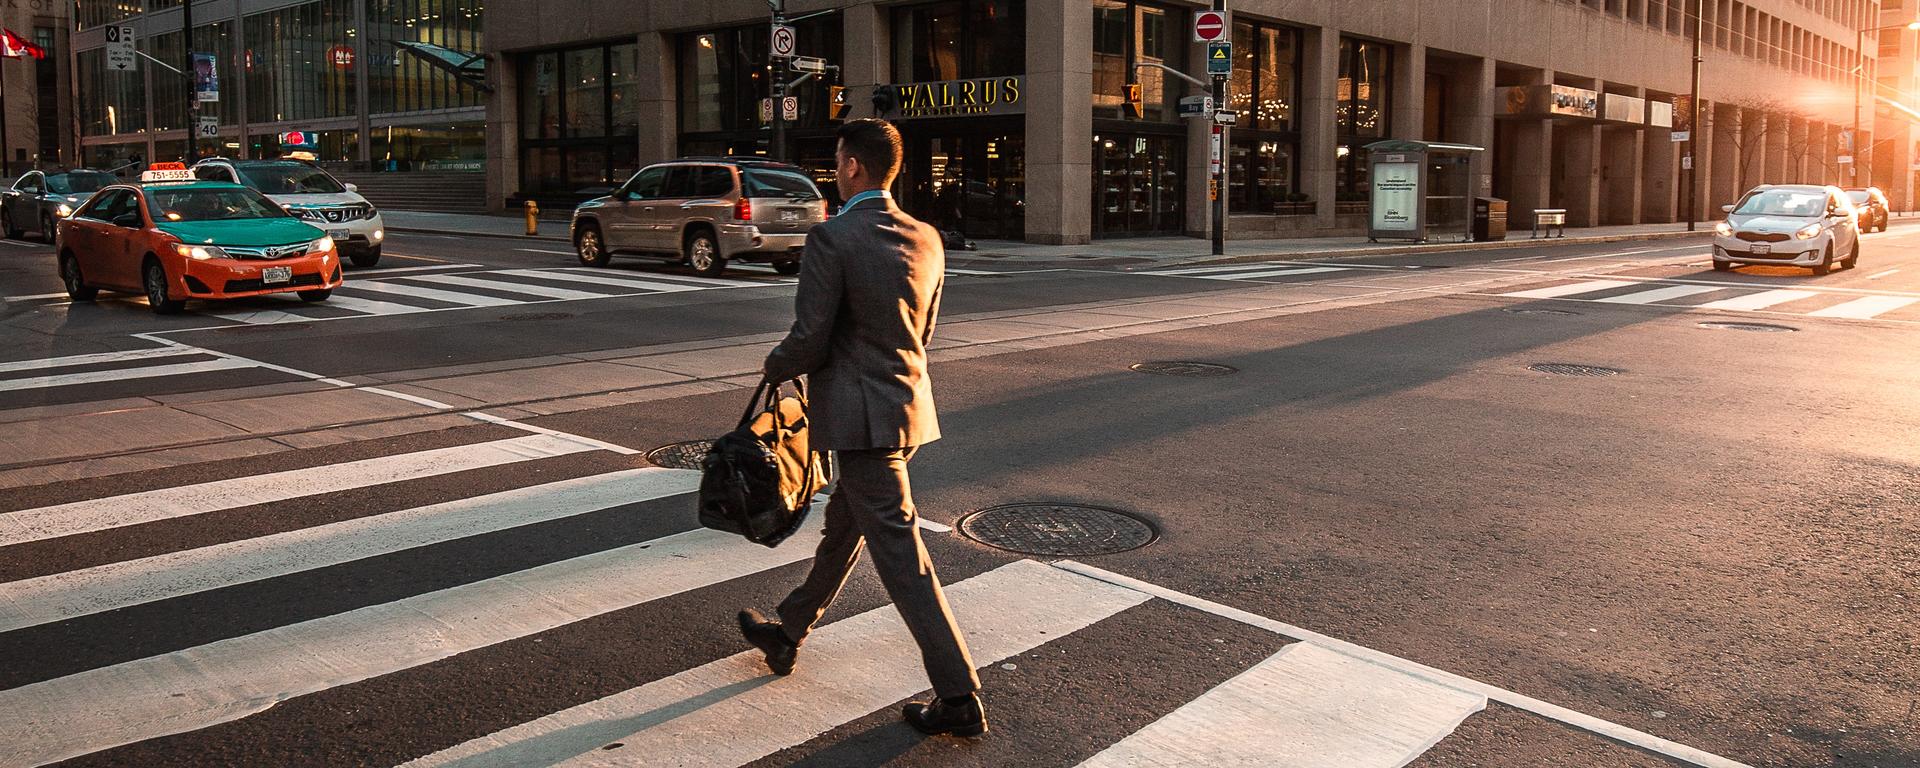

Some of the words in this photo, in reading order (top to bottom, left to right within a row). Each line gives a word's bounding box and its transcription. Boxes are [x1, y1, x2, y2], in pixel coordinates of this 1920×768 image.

[897, 77, 1019, 110] WALRUS
[1188, 104, 1199, 112] Bay
[202, 125, 217, 135] 40
[151, 171, 190, 179] 751-5555
